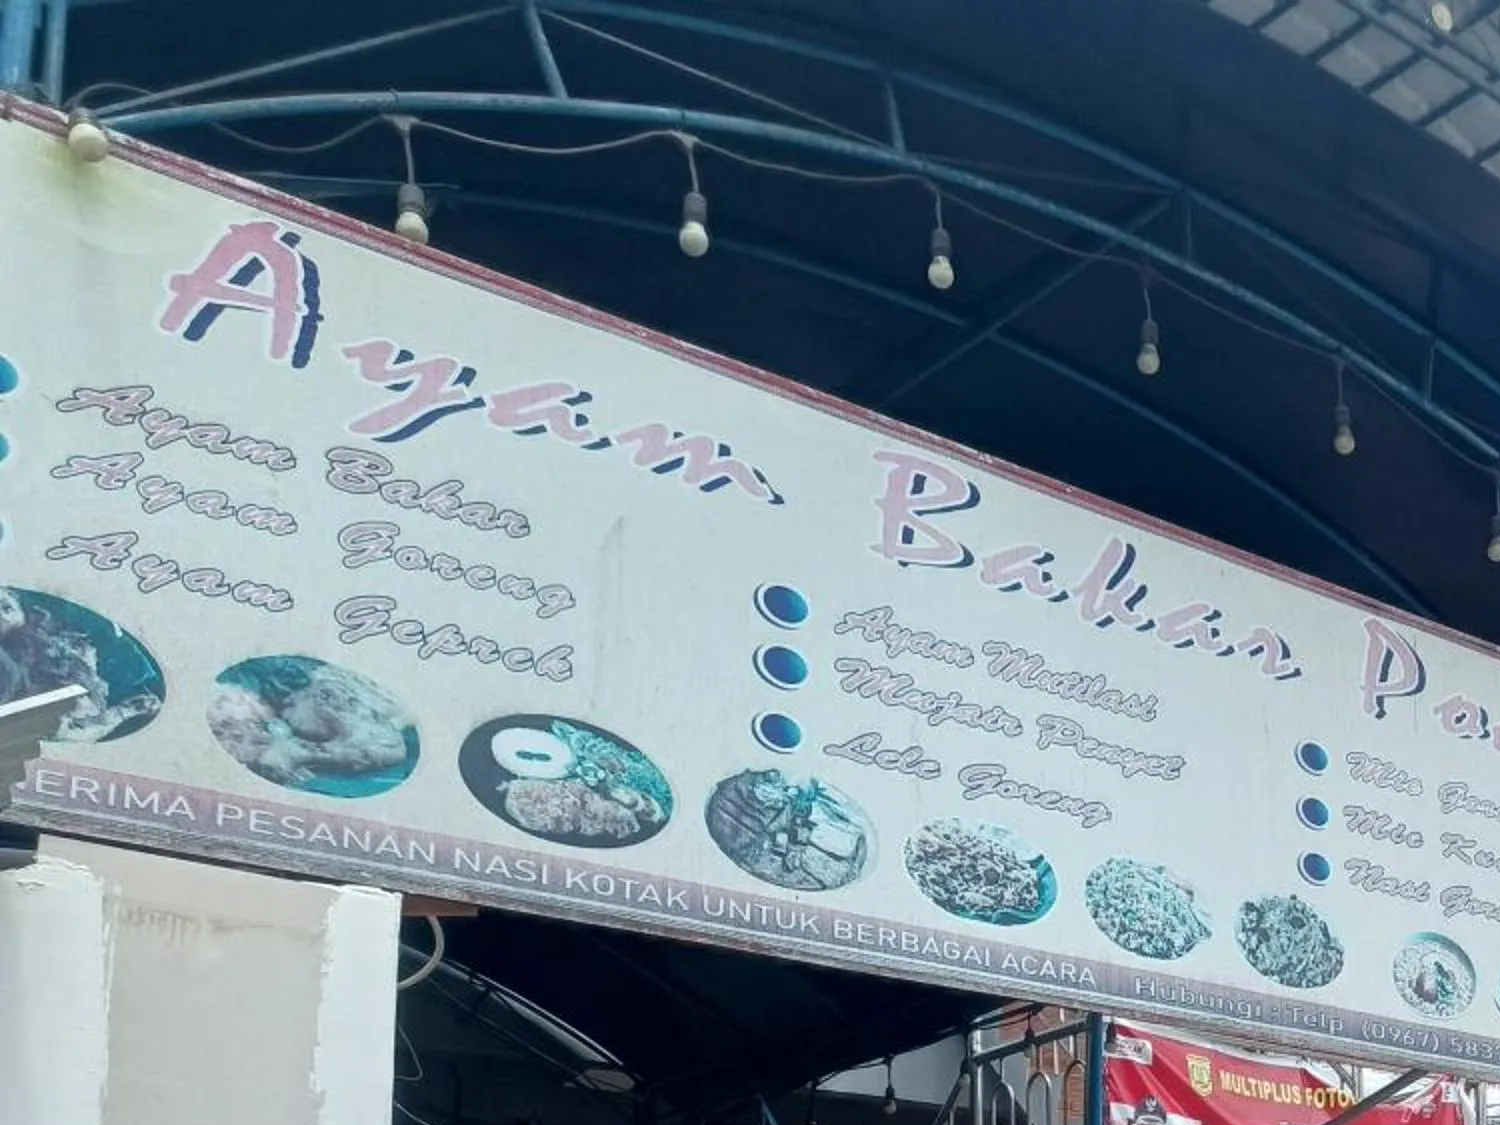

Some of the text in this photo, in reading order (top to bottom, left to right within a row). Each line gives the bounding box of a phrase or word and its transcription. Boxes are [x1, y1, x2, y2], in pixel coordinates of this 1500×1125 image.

[158, 221, 784, 505] Ayam
[50, 451, 576, 618] Ayam Goreng
[56, 385, 530, 538] Ayam Bakar
[46, 531, 573, 682] Ayam Geprek
[834, 605, 975, 669] Ayam
[822, 732, 1112, 829] Lele Goreng
[15, 769, 196, 821] ERIMA
[216, 803, 437, 865] PESANAN
[455, 848, 548, 884] NASI
[565, 868, 689, 911] KOTAK
[704, 893, 820, 933] UNTUK
[833, 918, 991, 966] BERBAGAI
[1001, 953, 1097, 986] ACARA
[1134, 976, 1262, 1018] Hubungi
[1289, 1007, 1344, 1034] Telp
[1344, 858, 1431, 902] Nasi
[1219, 1071, 1302, 1105] MULTIPLUS
